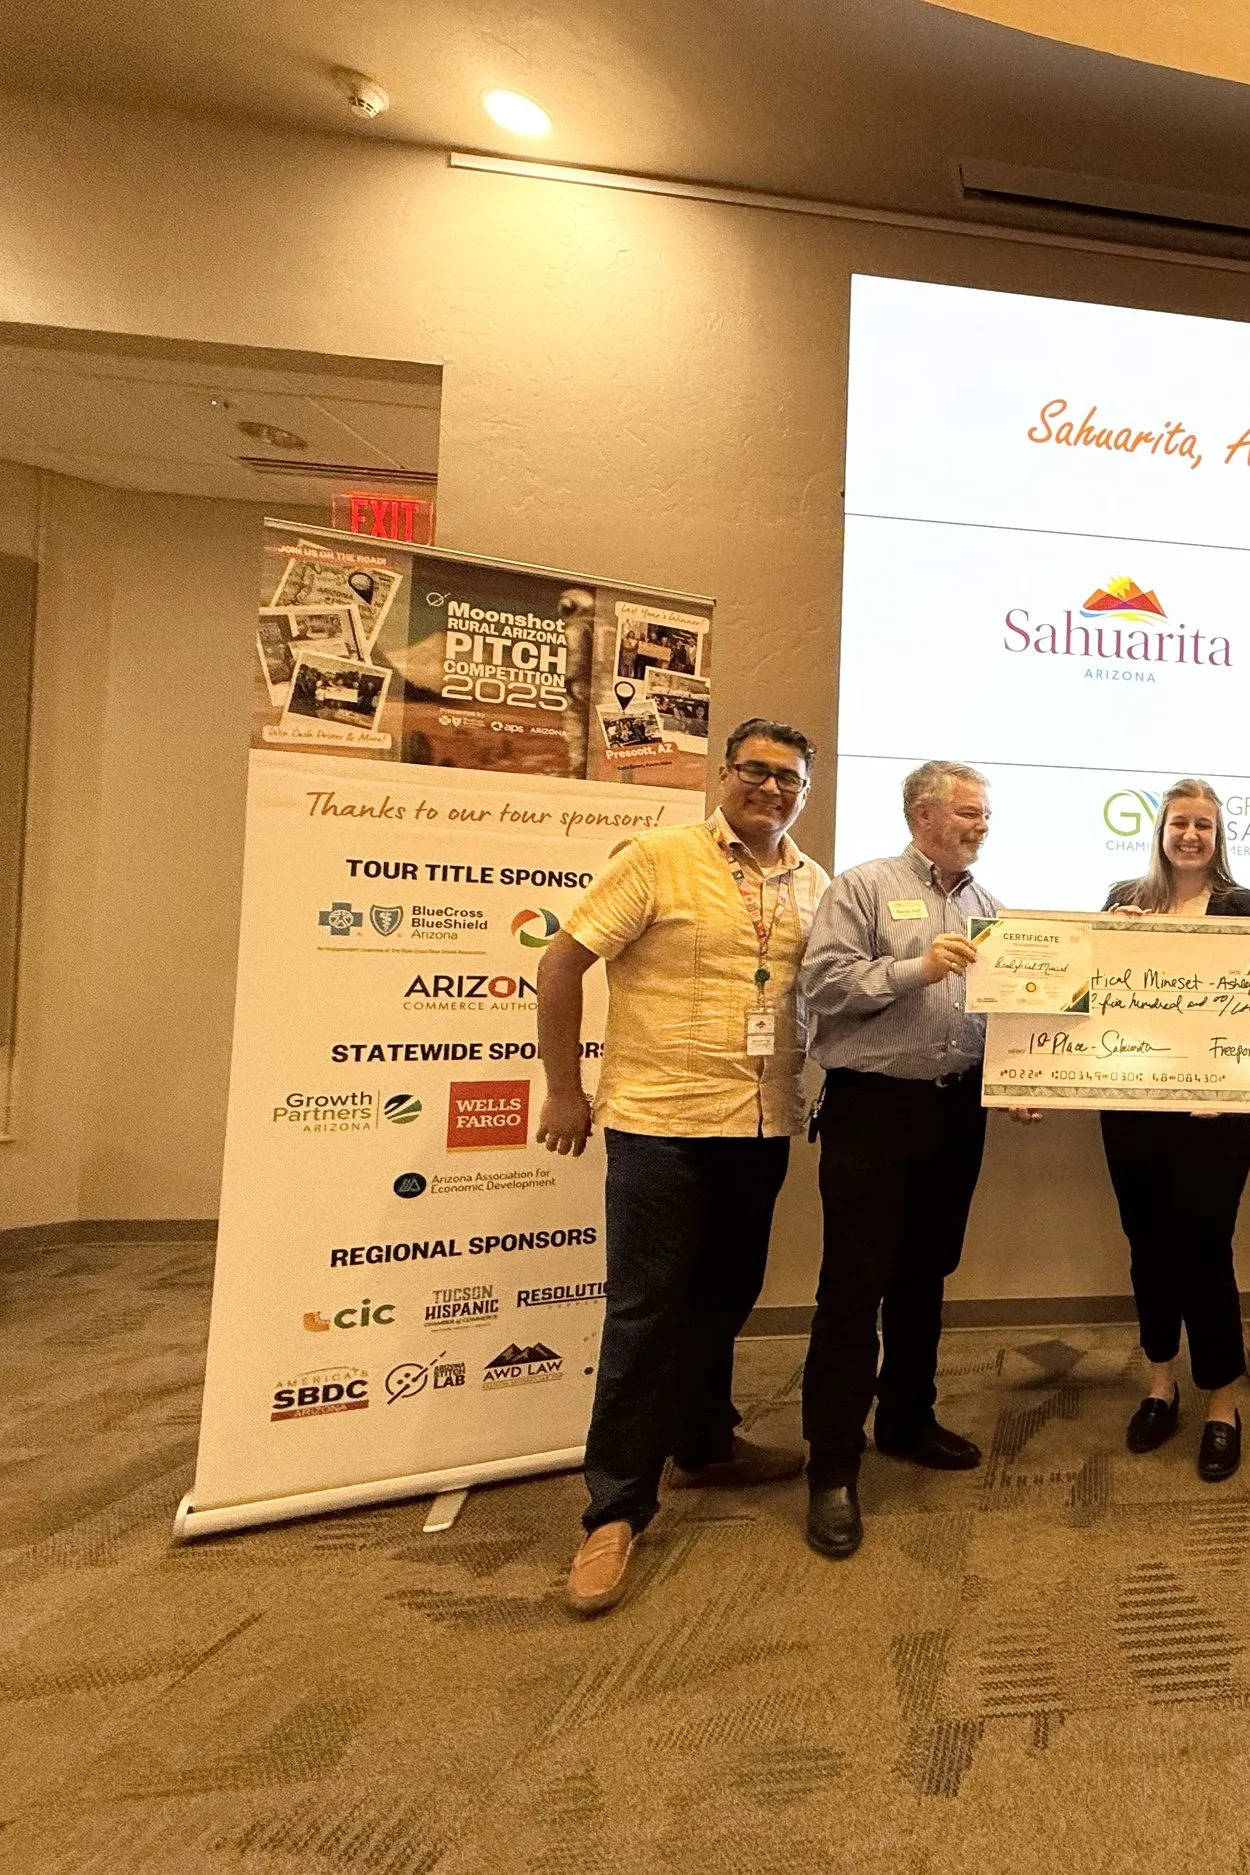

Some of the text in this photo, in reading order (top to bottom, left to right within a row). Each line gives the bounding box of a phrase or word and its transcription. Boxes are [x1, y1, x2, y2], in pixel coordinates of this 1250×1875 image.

[1027, 398, 1202, 469] Sahuarita,
[351, 498, 419, 542] EXIT
[447, 600, 565, 633] Moonshot
[447, 617, 567, 646] RURAL ARIZONA
[1003, 608, 1233, 667] Sahuarita
[446, 631, 567, 675] PITCH
[444, 660, 565, 688] COMPETITION
[1084, 669, 1156, 684] ARIZONA
[441, 674, 568, 712] 2025
[504, 723, 524, 733] aps
[605, 743, 674, 760] Prescott, AZ
[307, 791, 665, 837] Thanks to our tour sponsors!
[1105, 840, 1149, 852] CHAM
[346, 859, 594, 889] TOUR TITLE SPONSO
[412, 905, 484, 918] BlueCross
[411, 918, 488, 930] BlueShield
[411, 929, 458, 940] Arizona
[1003, 932, 1060, 944] CERTIFICATE
[404, 974, 538, 998] ARIZON
[403, 1001, 538, 1011] COMMERCE AUTHO
[331, 1042, 483, 1063] STATEWIDE
[286, 1091, 373, 1108] Growth
[455, 1097, 522, 1113] WELLS
[272, 1107, 372, 1122] Partners
[455, 1112, 522, 1129] FARGO
[303, 1122, 371, 1133] ARIZONA
[431, 1168, 551, 1184] Arizona Association for
[431, 1178, 557, 1194] Economic Development
[331, 1227, 598, 1268] REGIONAL SPONSORS
[432, 1284, 494, 1303] TUCSON
[424, 1299, 499, 1321] HISPANIC
[483, 1366, 522, 1382] AWD
[528, 1360, 563, 1376] LAW
[434, 1375, 466, 1390] LAB
[273, 1379, 369, 1410] SBDC
